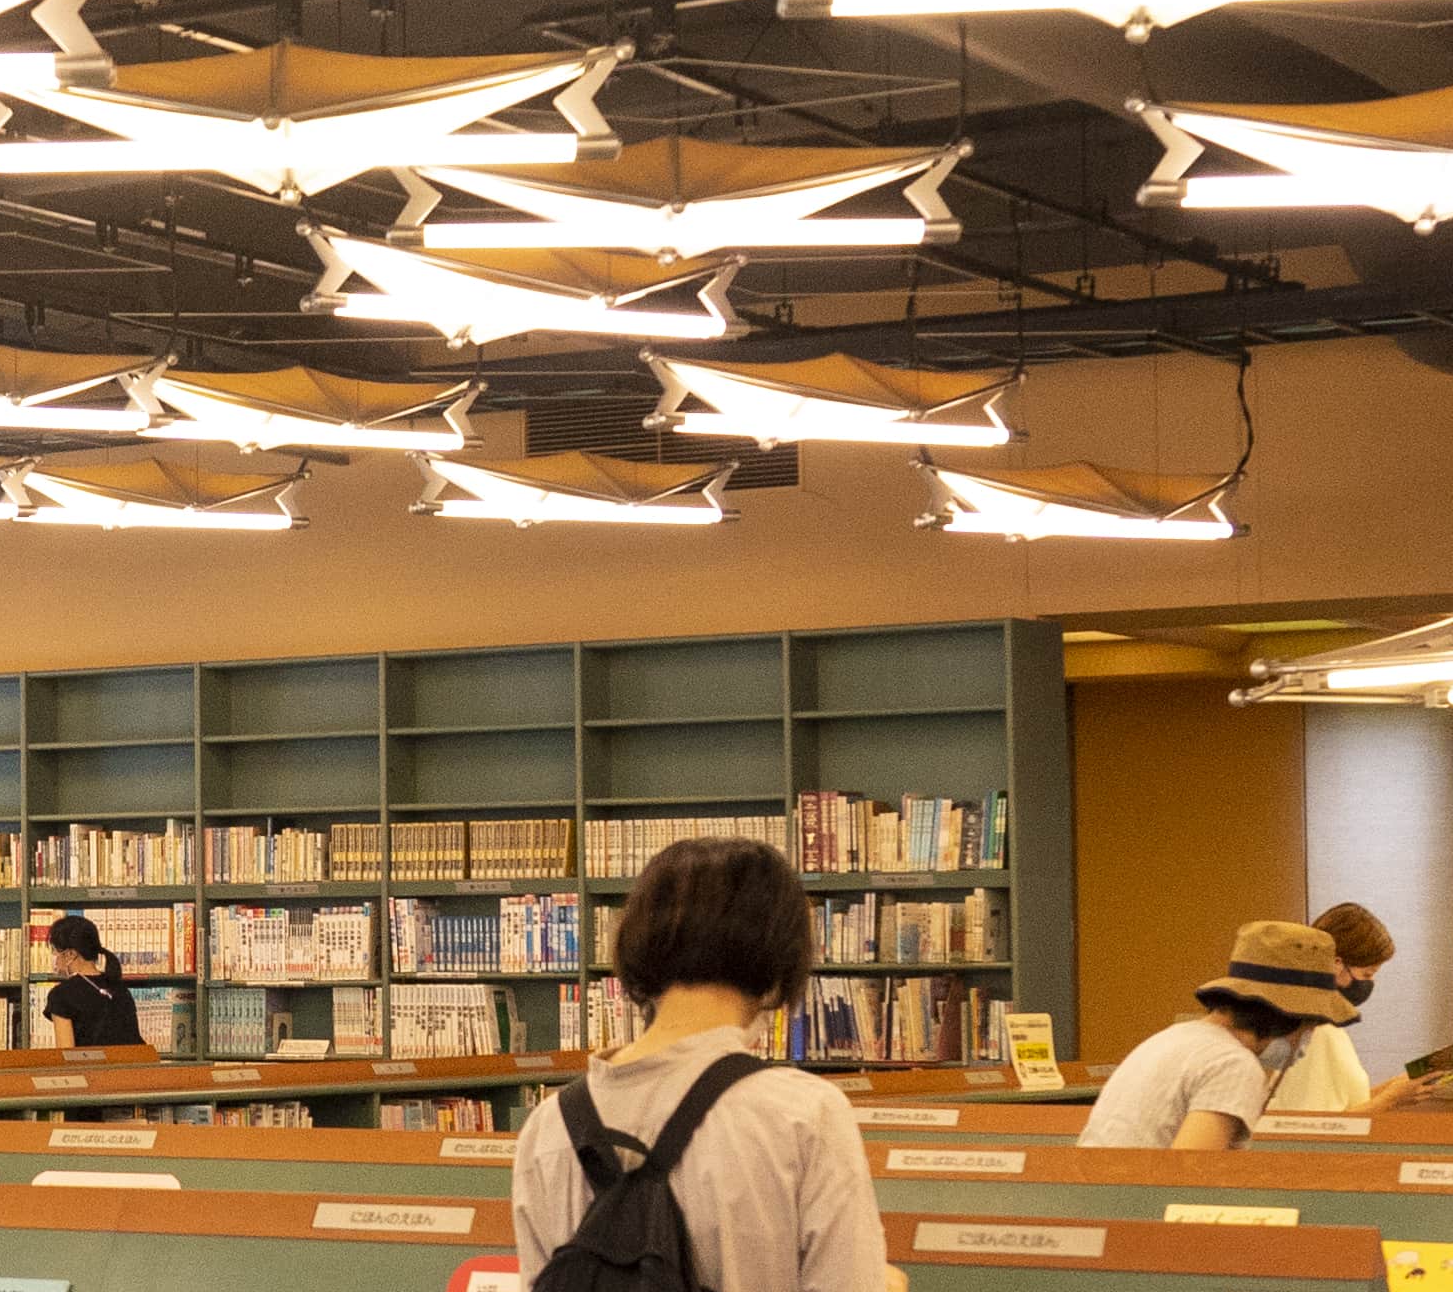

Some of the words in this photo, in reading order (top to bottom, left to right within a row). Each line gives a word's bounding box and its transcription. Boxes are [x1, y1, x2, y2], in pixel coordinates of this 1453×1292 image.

[350, 1211, 437, 1226] にほんのえほん
[956, 1233, 1060, 1250] にほんのえほん
